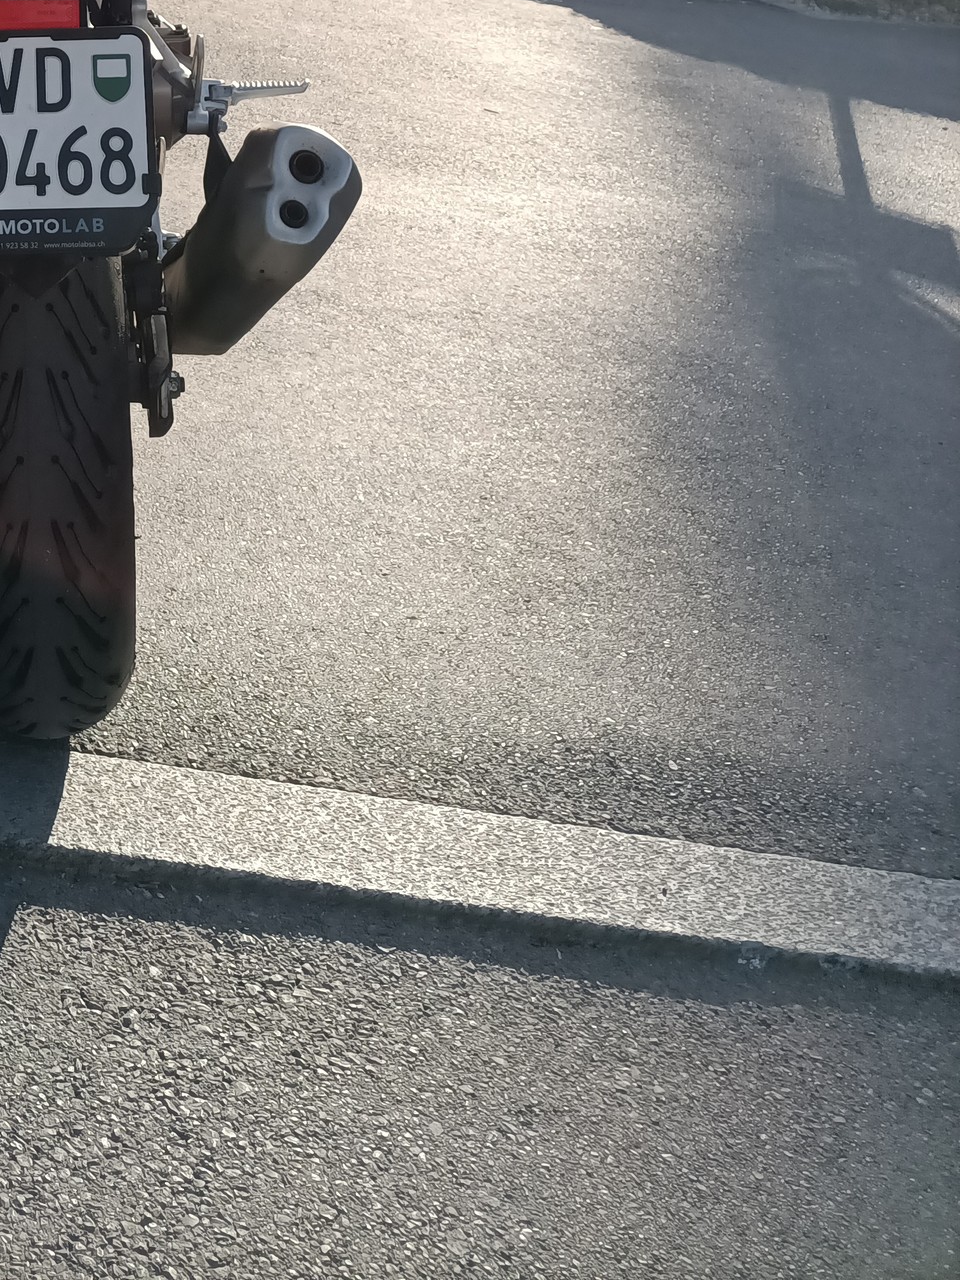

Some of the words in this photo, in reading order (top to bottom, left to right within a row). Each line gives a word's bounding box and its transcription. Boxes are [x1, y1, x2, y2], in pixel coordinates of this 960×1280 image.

[0, 218, 105, 235] MOTOLAB
[20, 241, 29, 249] 58
[30, 241, 39, 249] 32
